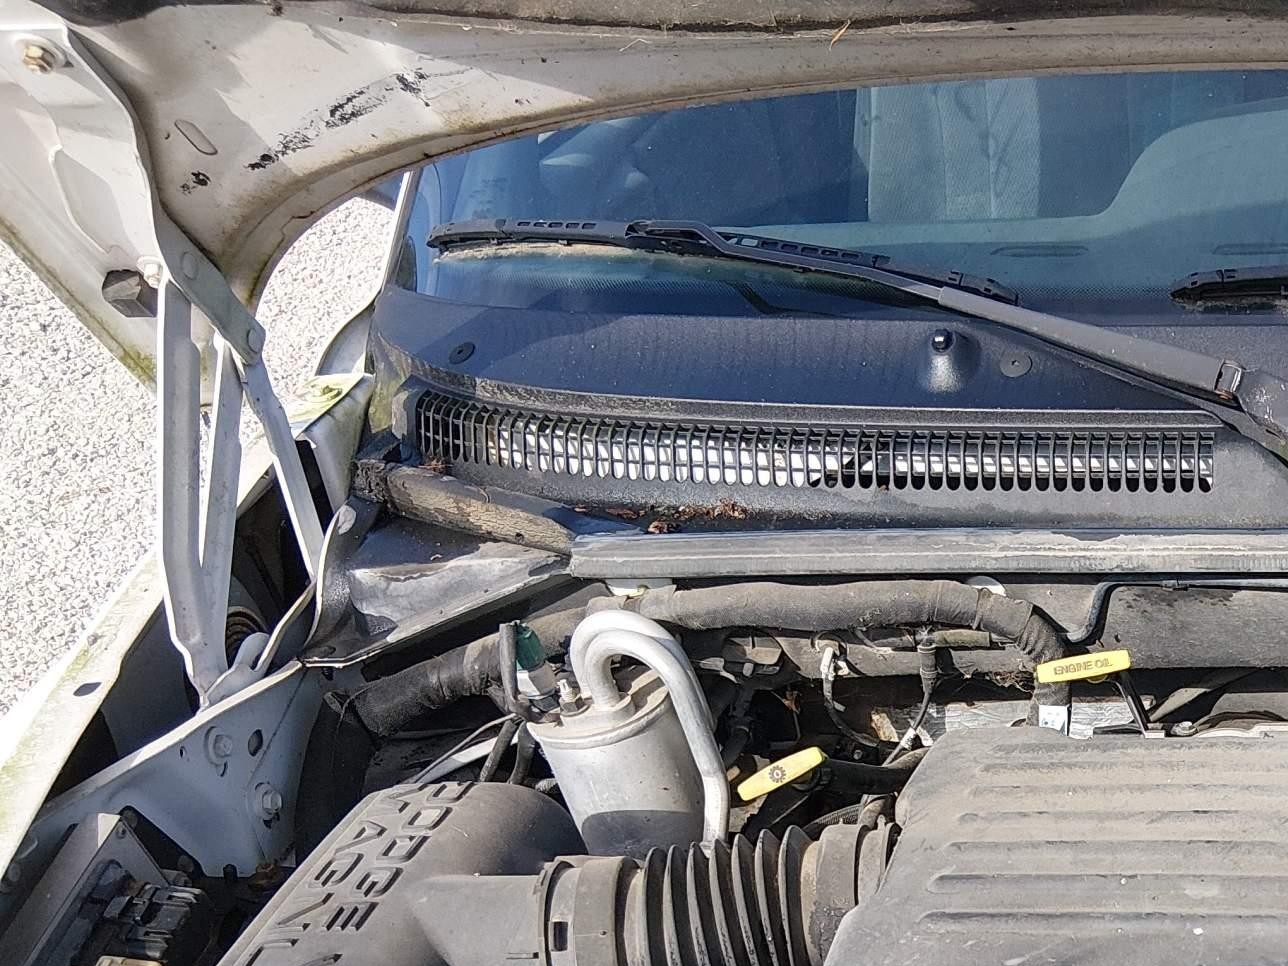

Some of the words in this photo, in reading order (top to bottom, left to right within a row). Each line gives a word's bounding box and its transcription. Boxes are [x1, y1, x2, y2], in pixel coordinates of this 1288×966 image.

[1054, 661, 1093, 675] ENGINE
[1095, 658, 1114, 670] OIL
[322, 781, 479, 933] DODGE
